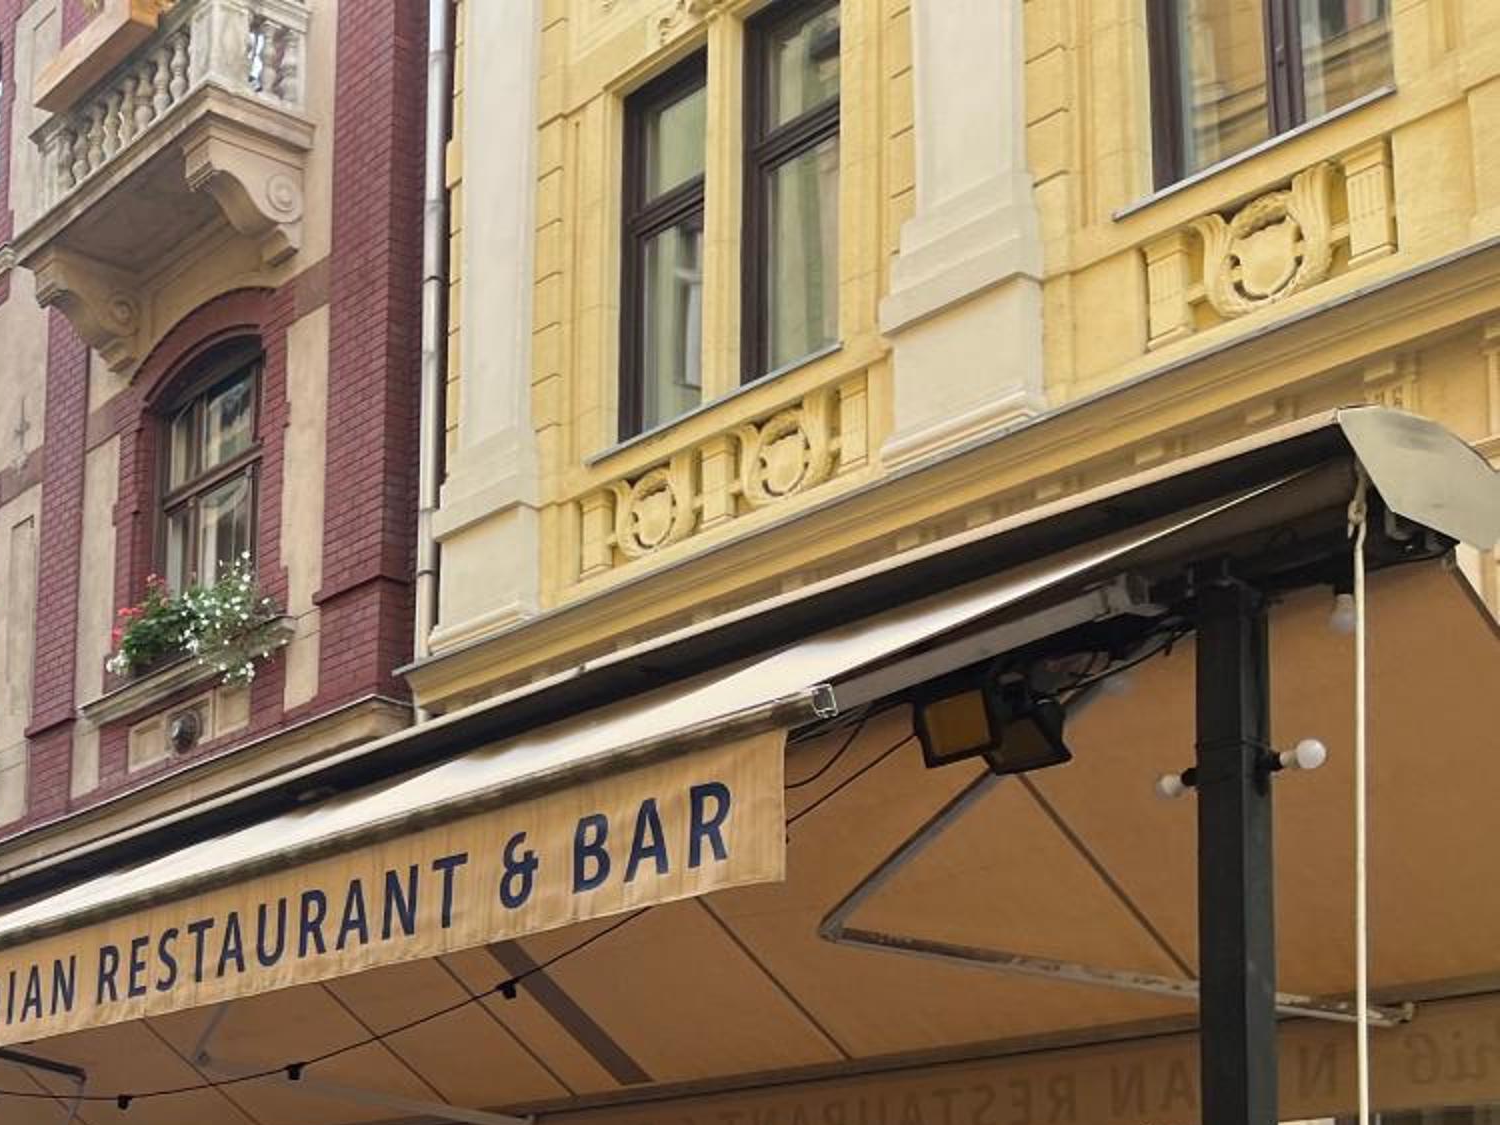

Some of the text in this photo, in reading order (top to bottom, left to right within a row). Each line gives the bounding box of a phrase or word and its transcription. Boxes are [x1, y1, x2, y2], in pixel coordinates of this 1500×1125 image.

[97, 853, 468, 1005] RESTAURANT
[499, 831, 539, 909] &
[572, 781, 732, 895] BAR
